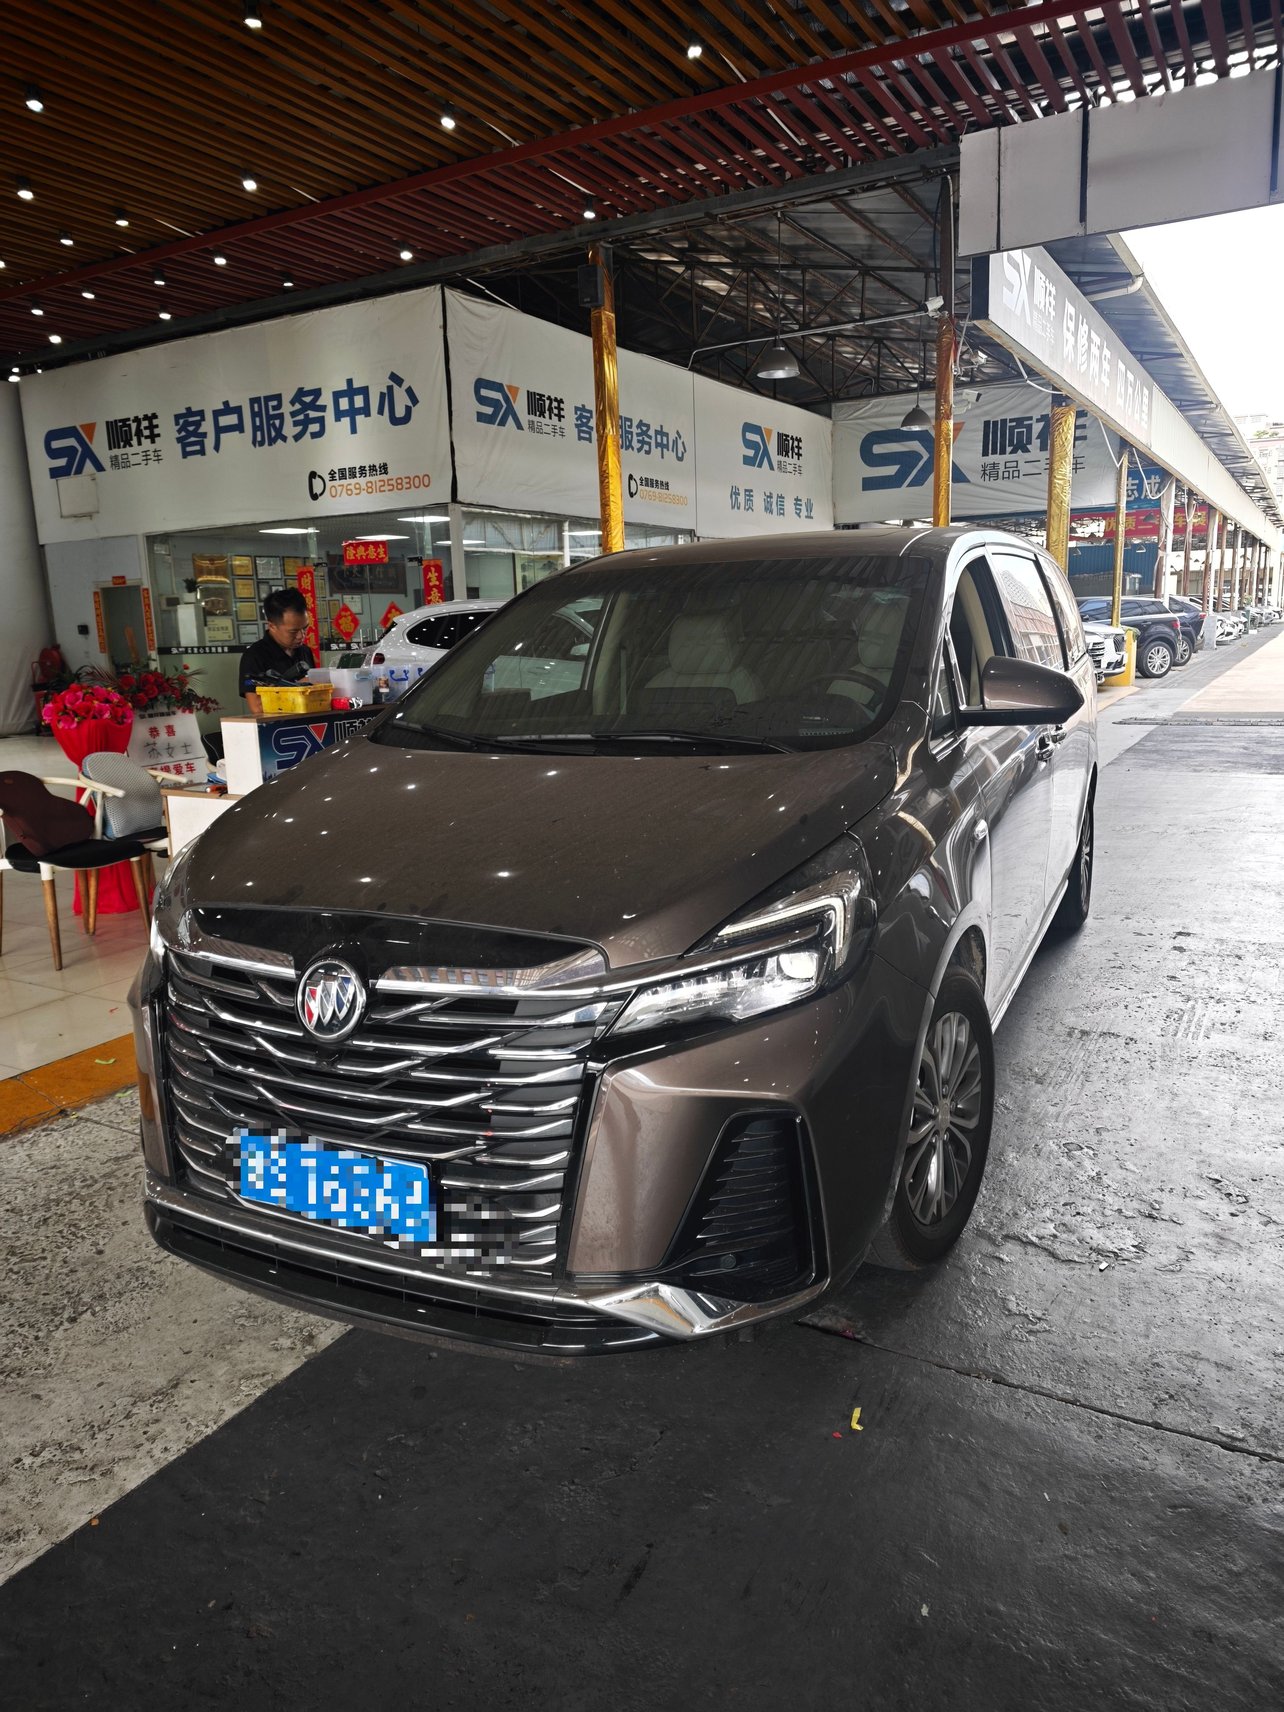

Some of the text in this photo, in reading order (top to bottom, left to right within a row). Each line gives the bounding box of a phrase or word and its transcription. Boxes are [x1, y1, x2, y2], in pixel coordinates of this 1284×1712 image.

[1063, 298, 1149, 430] 保修两年 四万公里
[173, 371, 420, 459] 客户服务中心
[474, 377, 524, 431] SX
[527, 389, 565, 422] 顺祥
[105, 412, 160, 451] 顺祥
[527, 419, 566, 439] 精品二手车
[573, 404, 687, 462] 客服务中心
[742, 422, 775, 471] SX
[777, 432, 803, 460] 顺祥
[44, 421, 106, 479] SX
[109, 448, 163, 471] 精品二手车
[327, 462, 389, 482] 全国服务热线
[329, 474, 431, 498] 0769-81258300
[730, 485, 814, 520] 优质 诚信 专业
[148, 724, 176, 739] 恭喜
